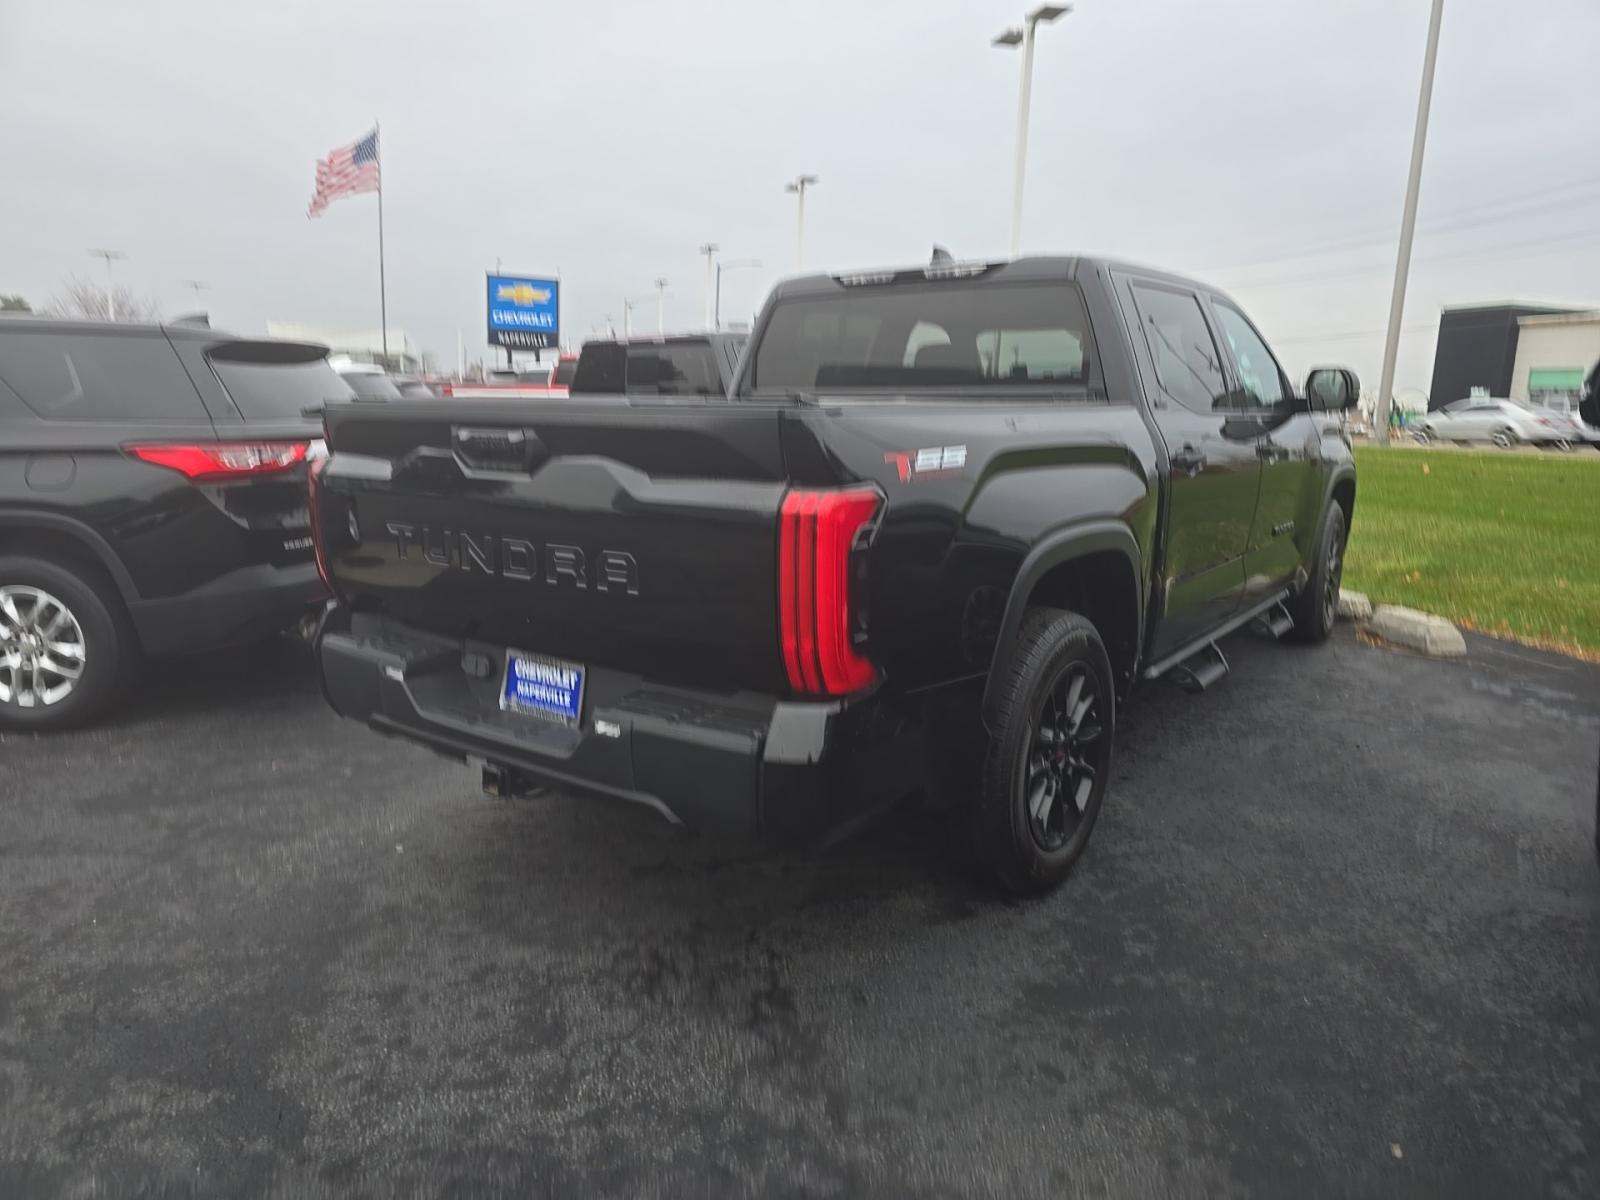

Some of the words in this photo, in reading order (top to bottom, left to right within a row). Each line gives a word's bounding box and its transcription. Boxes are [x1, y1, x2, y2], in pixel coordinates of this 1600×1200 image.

[492, 309, 553, 328] CHEVROLET
[497, 330, 548, 348] NAPERVILLE
[384, 520, 639, 595] TUNDRA
[514, 658, 579, 691] CHEVROLET
[516, 680, 572, 708] NAPERVILLE
